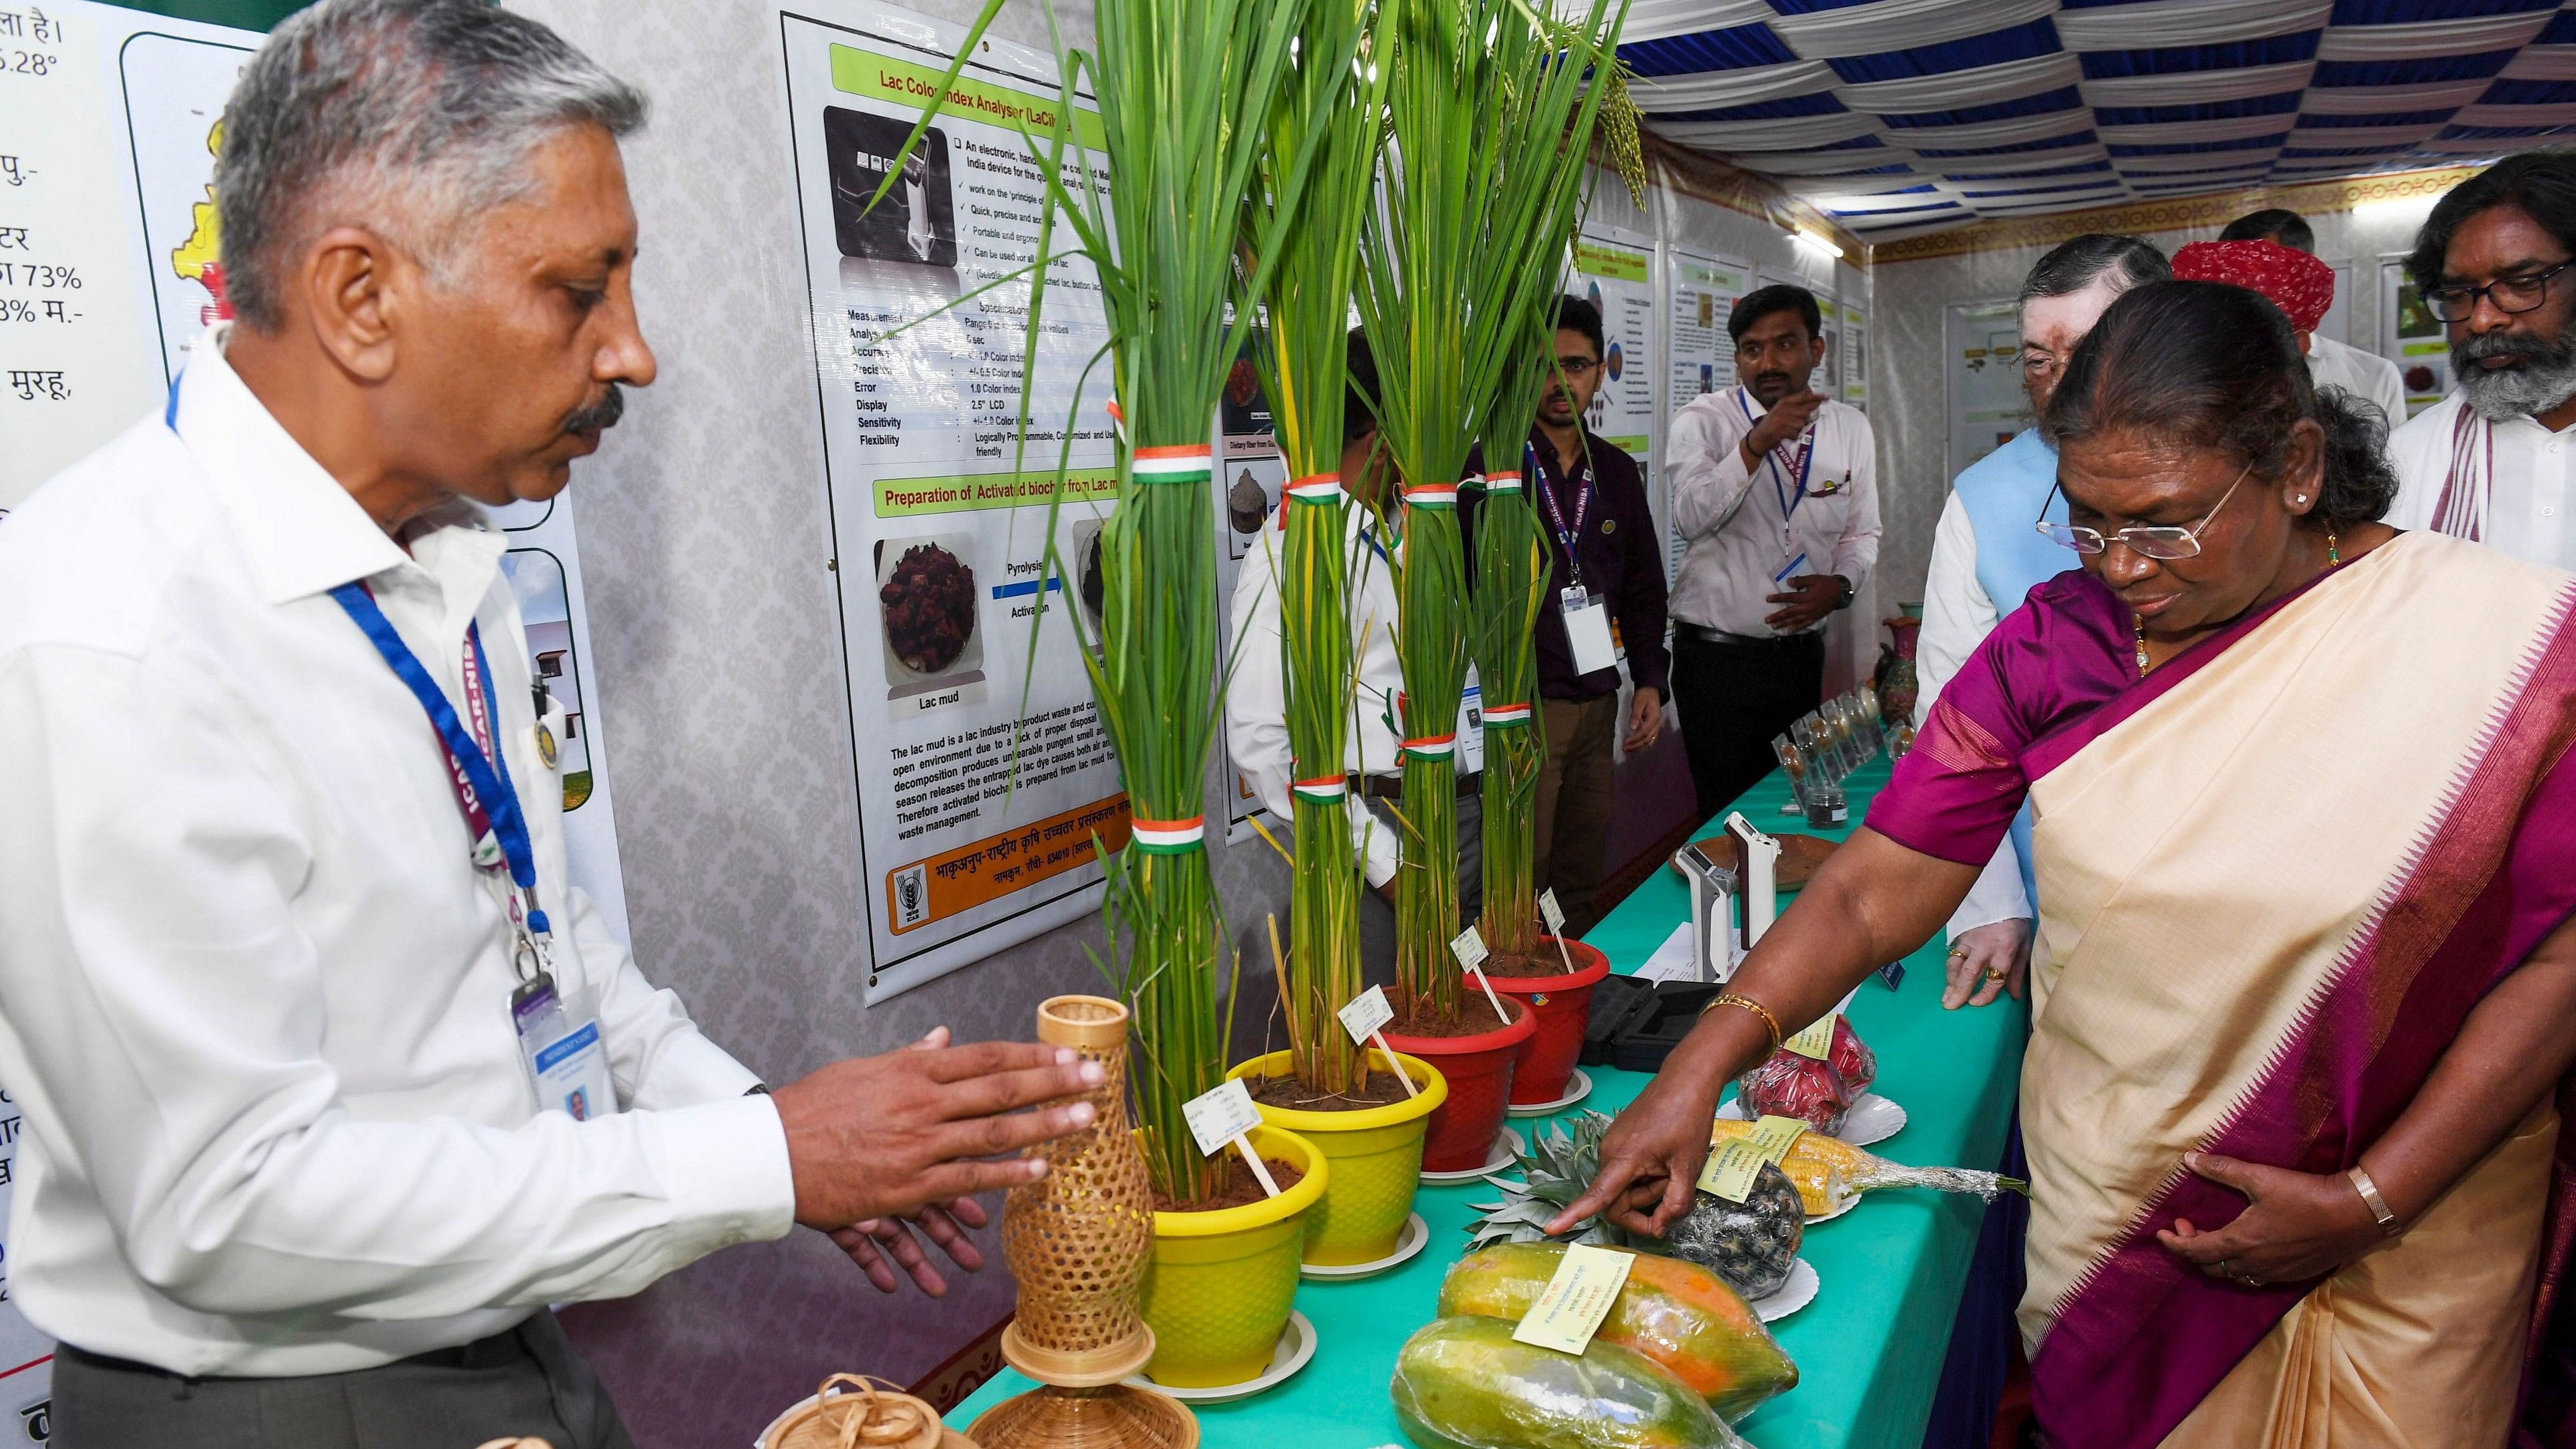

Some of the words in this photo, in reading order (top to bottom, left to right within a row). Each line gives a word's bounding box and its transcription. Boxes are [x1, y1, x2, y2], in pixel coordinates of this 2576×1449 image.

[880, 70, 903, 91] Lac
[966, 140, 977, 152] An
[979, 144, 1018, 162] electronic,
[967, 156, 986, 171] India
[988, 162, 1012, 175] device
[1013, 166, 1023, 178] for
[1025, 170, 1035, 180] the
[969, 183, 985, 194] work
[987, 187, 996, 196] on
[997, 188, 1008, 198] the
[971, 204, 992, 218] Quick,
[994, 210, 1017, 221] precise
[1019, 213, 1031, 223] and
[973, 225, 1000, 239] Portable
[1002, 229, 1014, 241] and
[974, 247, 988, 258] Can
[990, 249, 998, 259] be
[1000, 251, 1015, 262] used
[22, 264, 82, 289] 73%
[974, 335, 985, 345] sec
[990, 351, 1008, 363] Color
[854, 381, 876, 393] Error
[971, 383, 981, 393] 1.0
[983, 384, 1002, 394] Color
[856, 399, 888, 412] Display
[990, 401, 1004, 410] LCD
[858, 417, 901, 430] Sensitivity
[996, 416, 1015, 426] Color
[860, 434, 900, 447] Flexibility
[975, 431, 1006, 445] Logically
[1093, 431, 1103, 439] and
[976, 447, 1002, 458] friendly
[885, 488, 958, 509] Preparation
[960, 485, 973, 501] of
[1092, 477, 1108, 493] Lac
[1008, 560, 1043, 575] Pyrolysis
[920, 695, 937, 710] Lac
[939, 691, 959, 707] mud
[891, 749, 908, 760] The
[910, 745, 924, 755] lac
[926, 737, 945, 751] mud
[948, 736, 956, 746] is
[966, 731, 978, 741] lac
[980, 722, 1012, 738] industry
[1023, 712, 1050, 729] product
[1051, 707, 1071, 720] waste
[1073, 702, 1085, 714] and
[893, 763, 915, 777] open
[920, 747, 972, 769] environment
[976, 743, 991, 754] due
[995, 739, 1003, 749] to
[1034, 728, 1042, 739] of
[1045, 723, 1067, 737] proper
[1070, 713, 1097, 729] disposal
[894, 768, 958, 792] decomposition
[962, 756, 999, 777] produces
[1047, 734, 1074, 753] pungent
[1077, 728, 1094, 741] smell
[896, 793, 928, 809] season
[930, 781, 965, 799] releases
[968, 777, 980, 788] the
[1023, 761, 1034, 772] lac
[1037, 757, 1049, 770] dye
[1051, 750, 1075, 763] causes
[1077, 743, 1091, 756] both
[897, 805, 938, 824] Therefore
[943, 791, 980, 811] activated
[1016, 779, 1023, 789] is
[1026, 767, 1058, 789] prepared
[1061, 765, 1076, 776] from
[1079, 760, 1089, 770] lac
[1091, 753, 1105, 766] mud
[898, 826, 924, 841] waste
[926, 807, 981, 833] management.
[1021, 828, 1040, 853] कृषि
[1044, 819, 1074, 841] उच्चतर
[1077, 805, 1115, 831] प्रसंस्करण
[994, 865, 1023, 883] नामकुम,
[1047, 847, 1069, 865] 834010
